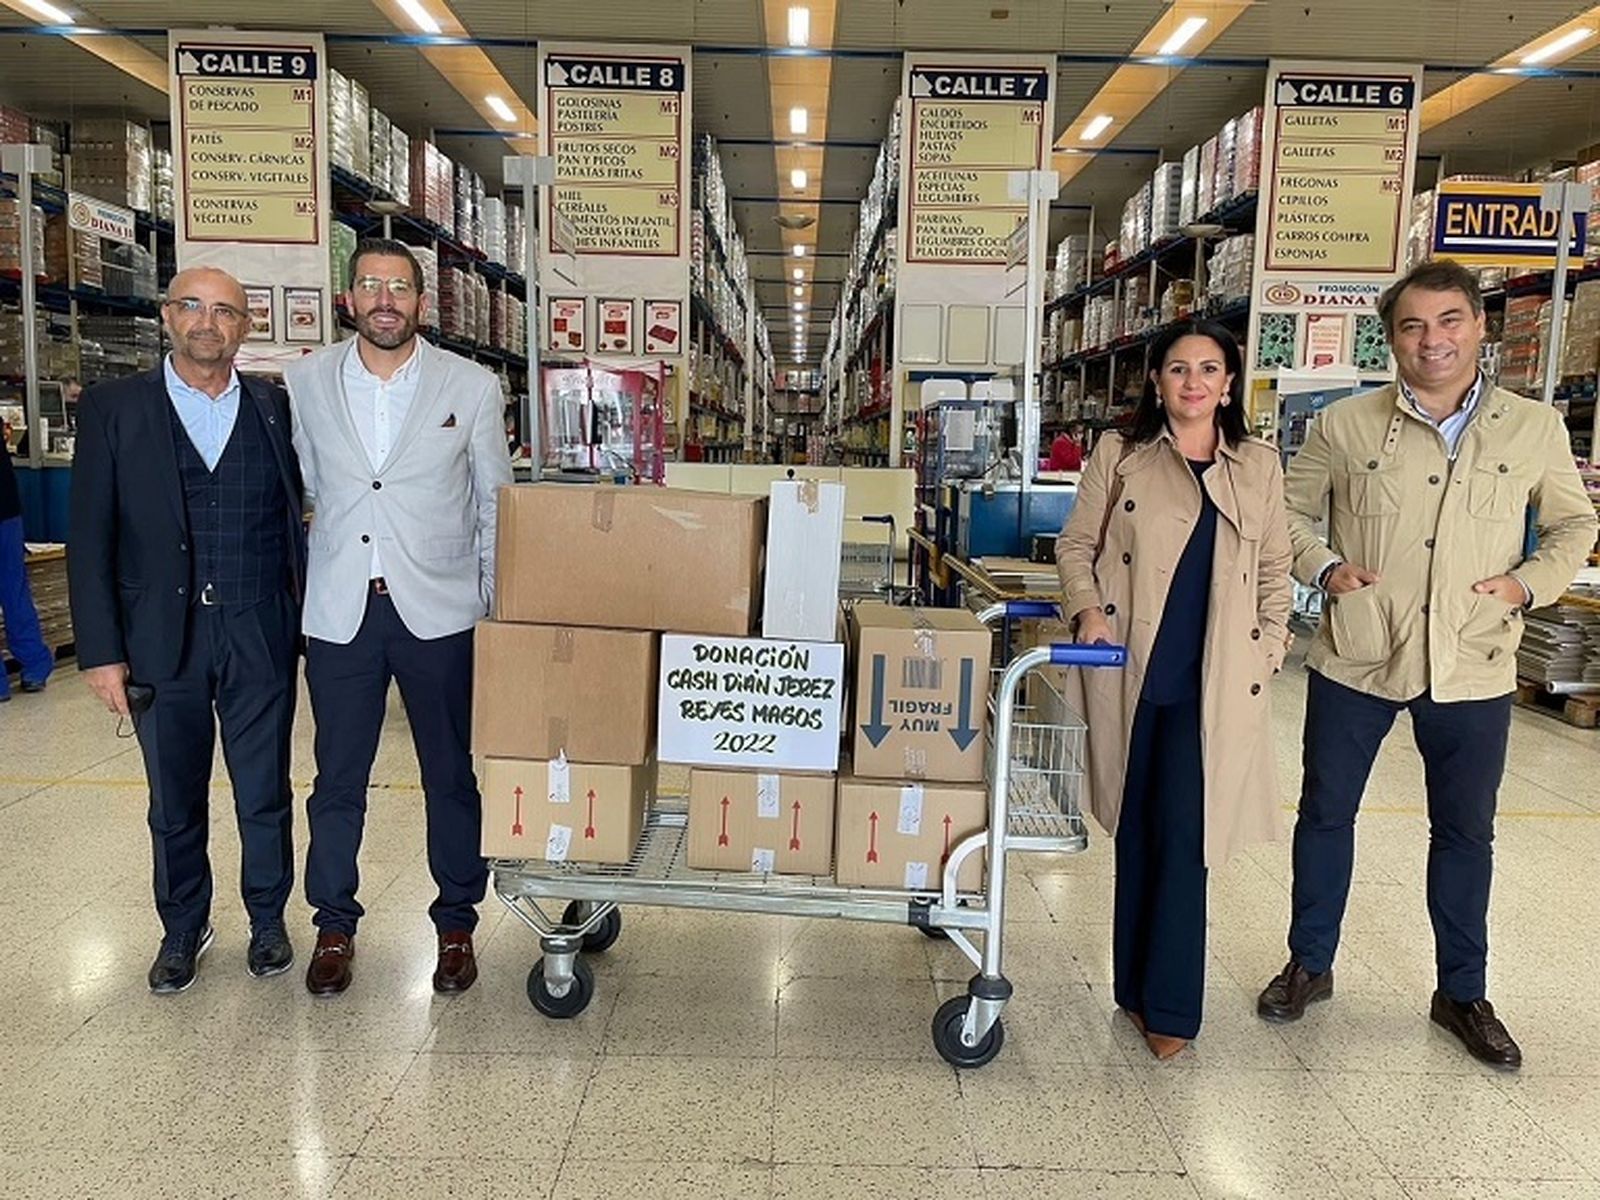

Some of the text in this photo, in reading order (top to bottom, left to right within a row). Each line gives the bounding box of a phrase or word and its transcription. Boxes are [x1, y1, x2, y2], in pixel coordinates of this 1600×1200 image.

[201, 54, 307, 75] CALLE 9
[570, 65, 674, 87] CALLE 8
[188, 85, 255, 97] CONSERVAS
[935, 76, 1039, 96] CALLE 7
[293, 89, 312, 99] M1
[1300, 84, 1404, 104] CALLE 6
[189, 101, 259, 112] DE PESCADO
[557, 97, 622, 109] GOLOSINAS
[660, 101, 678, 113] M1
[920, 108, 963, 118] CALDOS
[1022, 110, 1041, 122] M1
[920, 120, 988, 130] ENCURTIDOS
[1284, 116, 1338, 126] GALLETAS
[1387, 118, 1406, 130] M1
[557, 122, 603, 132] POSTRES
[920, 131, 963, 141] HUEVOS
[294, 137, 314, 149] M2
[919, 142, 956, 152] PASTAS
[557, 143, 636, 155] FRUTOS SECOS
[659, 146, 678, 157] M2
[1282, 147, 1335, 157] GALLETAS
[557, 155, 626, 166] PAN Y PICOS
[918, 153, 951, 163] SOPAS
[1385, 150, 1403, 161] M2
[249, 172, 309, 183] VEGETALES
[557, 168, 643, 179] PATATAS FRITAS
[918, 171, 978, 181] ACEITUNAS
[918, 182, 965, 192] ESPECIAS
[1280, 178, 1338, 188] FREGONAS
[1382, 180, 1401, 192] M3
[557, 191, 582, 200] MIEL
[660, 193, 678, 206] M3
[917, 193, 980, 203] LEGUMBRES
[1278, 196, 1328, 206] CEPILLOS
[193, 199, 259, 209] CONSERVAS
[296, 202, 315, 213] M3
[558, 202, 607, 213] CEREALES
[193, 213, 253, 224] VEGETALES
[916, 215, 962, 224] HARINAS
[1445, 203, 1576, 238] ENTRAD
[574, 225, 659, 237] NSERVAS FRUTA
[916, 225, 984, 236] PAN RAYADO
[916, 236, 975, 246] LEGUMBRES
[1276, 231, 1370, 242] CARROS COMPRA
[600, 238, 660, 248] INFANTILES
[916, 248, 953, 257] PLATOS
[1274, 249, 1327, 260] ESPONJAS
[1303, 295, 1366, 305] DIANA
[667, 668, 717, 691] CASH
[774, 675, 836, 700] JEREZ
[889, 700, 952, 715] FRAGIL
[680, 700, 822, 730] REYES MAGOS
[900, 718, 940, 732] MUY
[714, 732, 776, 753] 2022
